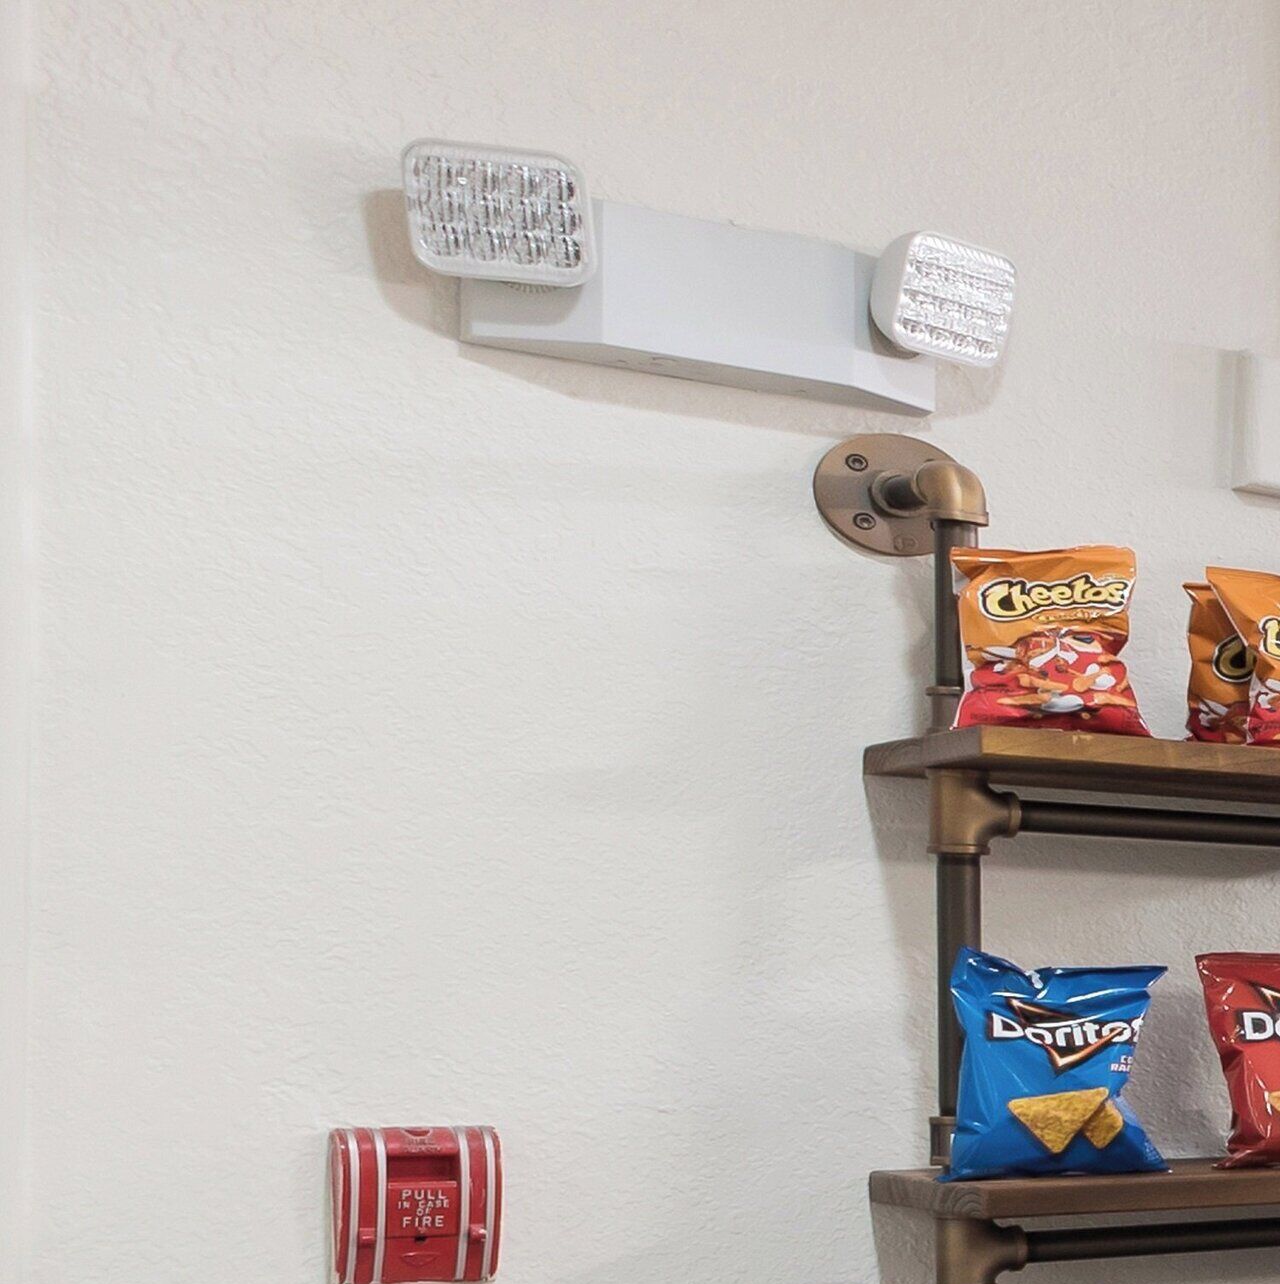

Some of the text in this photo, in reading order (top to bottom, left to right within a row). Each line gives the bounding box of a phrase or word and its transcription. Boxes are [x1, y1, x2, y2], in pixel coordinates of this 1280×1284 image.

[983, 572, 1129, 619] Cheetos
[402, 1189, 447, 1200] PULL
[418, 1199, 450, 1210] CASE
[402, 1215, 445, 1229] FIRE
